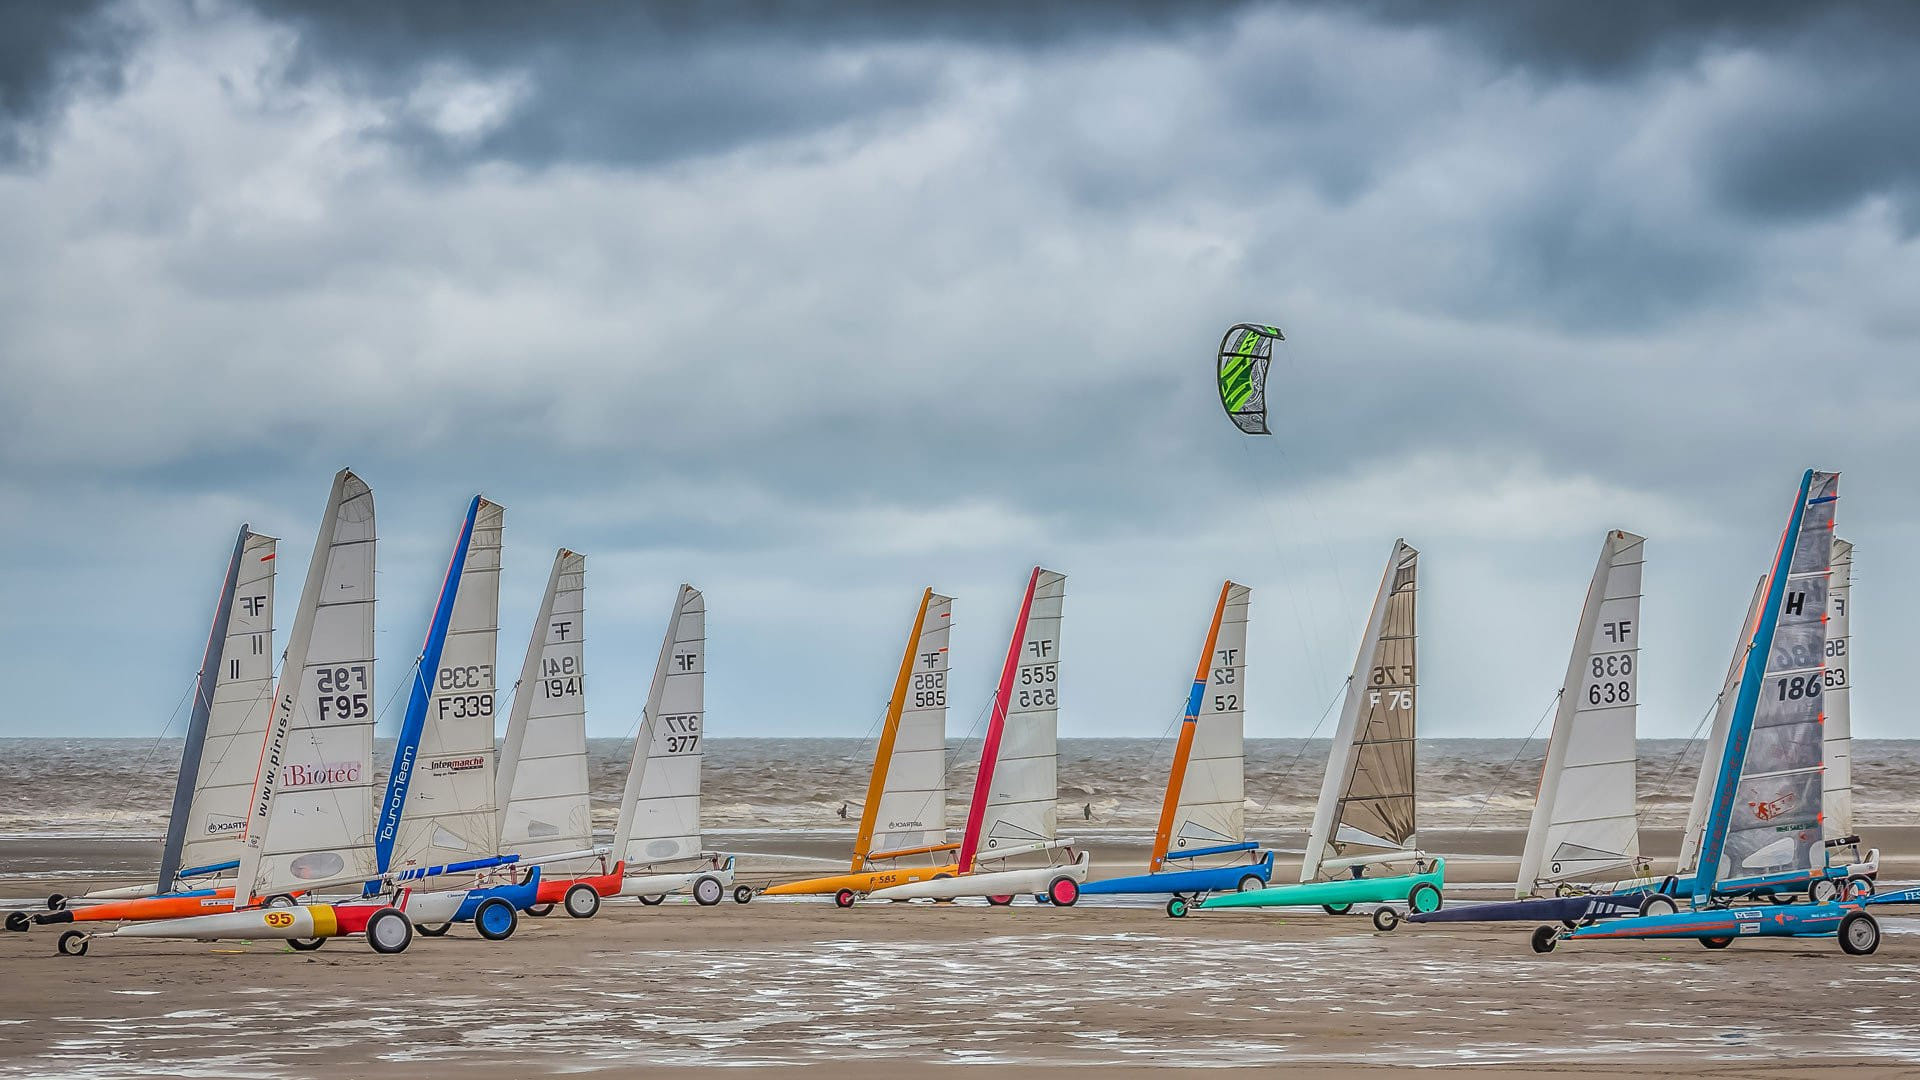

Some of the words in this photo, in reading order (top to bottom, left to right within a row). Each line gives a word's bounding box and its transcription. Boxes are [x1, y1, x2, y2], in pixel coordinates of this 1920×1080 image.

[1785, 592, 1805, 616] H
[1022, 665, 1056, 685] 555
[545, 677, 582, 698] 1941
[1589, 681, 1630, 705] 638
[1778, 674, 1822, 701] 186
[318, 694, 368, 720] F95
[439, 695, 493, 720] F339
[916, 690, 946, 707] 585
[1216, 695, 1238, 711] 52
[1370, 692, 1381, 709] F
[1389, 691, 1412, 710] 76
[667, 735, 698, 752] 377
[259, 694, 293, 817] www.pirus.fr
[268, 913, 292, 925] 95
